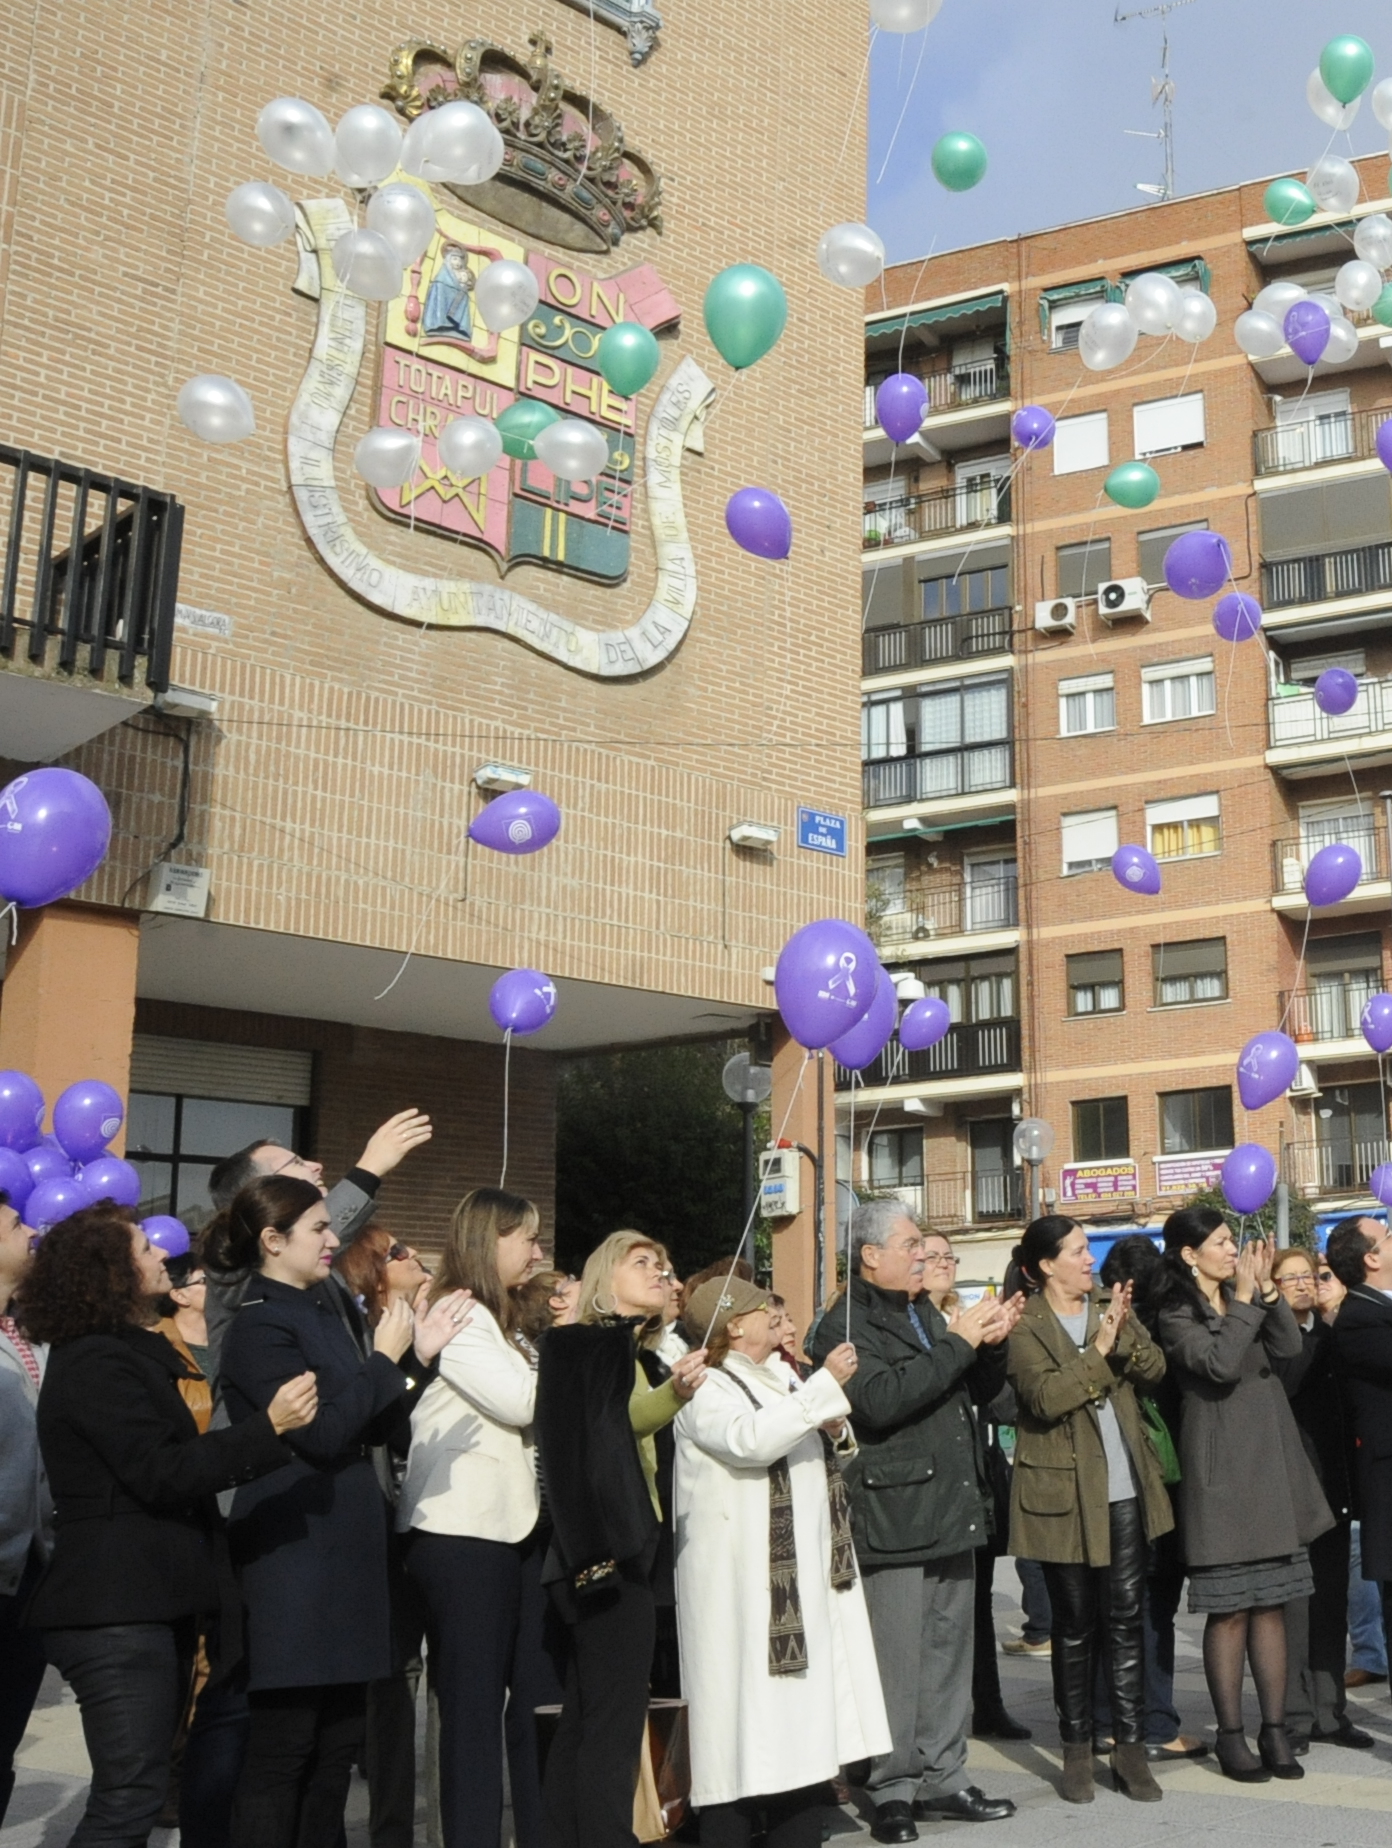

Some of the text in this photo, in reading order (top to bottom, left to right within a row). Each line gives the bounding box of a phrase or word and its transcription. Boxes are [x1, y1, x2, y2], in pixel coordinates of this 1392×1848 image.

[655, 382, 693, 489] MOSTOLES
[662, 511, 680, 538] DE
[408, 585, 579, 653] AYUNTAMIENTO
[642, 621, 672, 649] LA
[604, 642, 635, 664] DE
[815, 815, 841, 829] PLAZA
[808, 833, 837, 849] ESPAÑA
[1076, 1166, 1135, 1178] ABOGADOS
